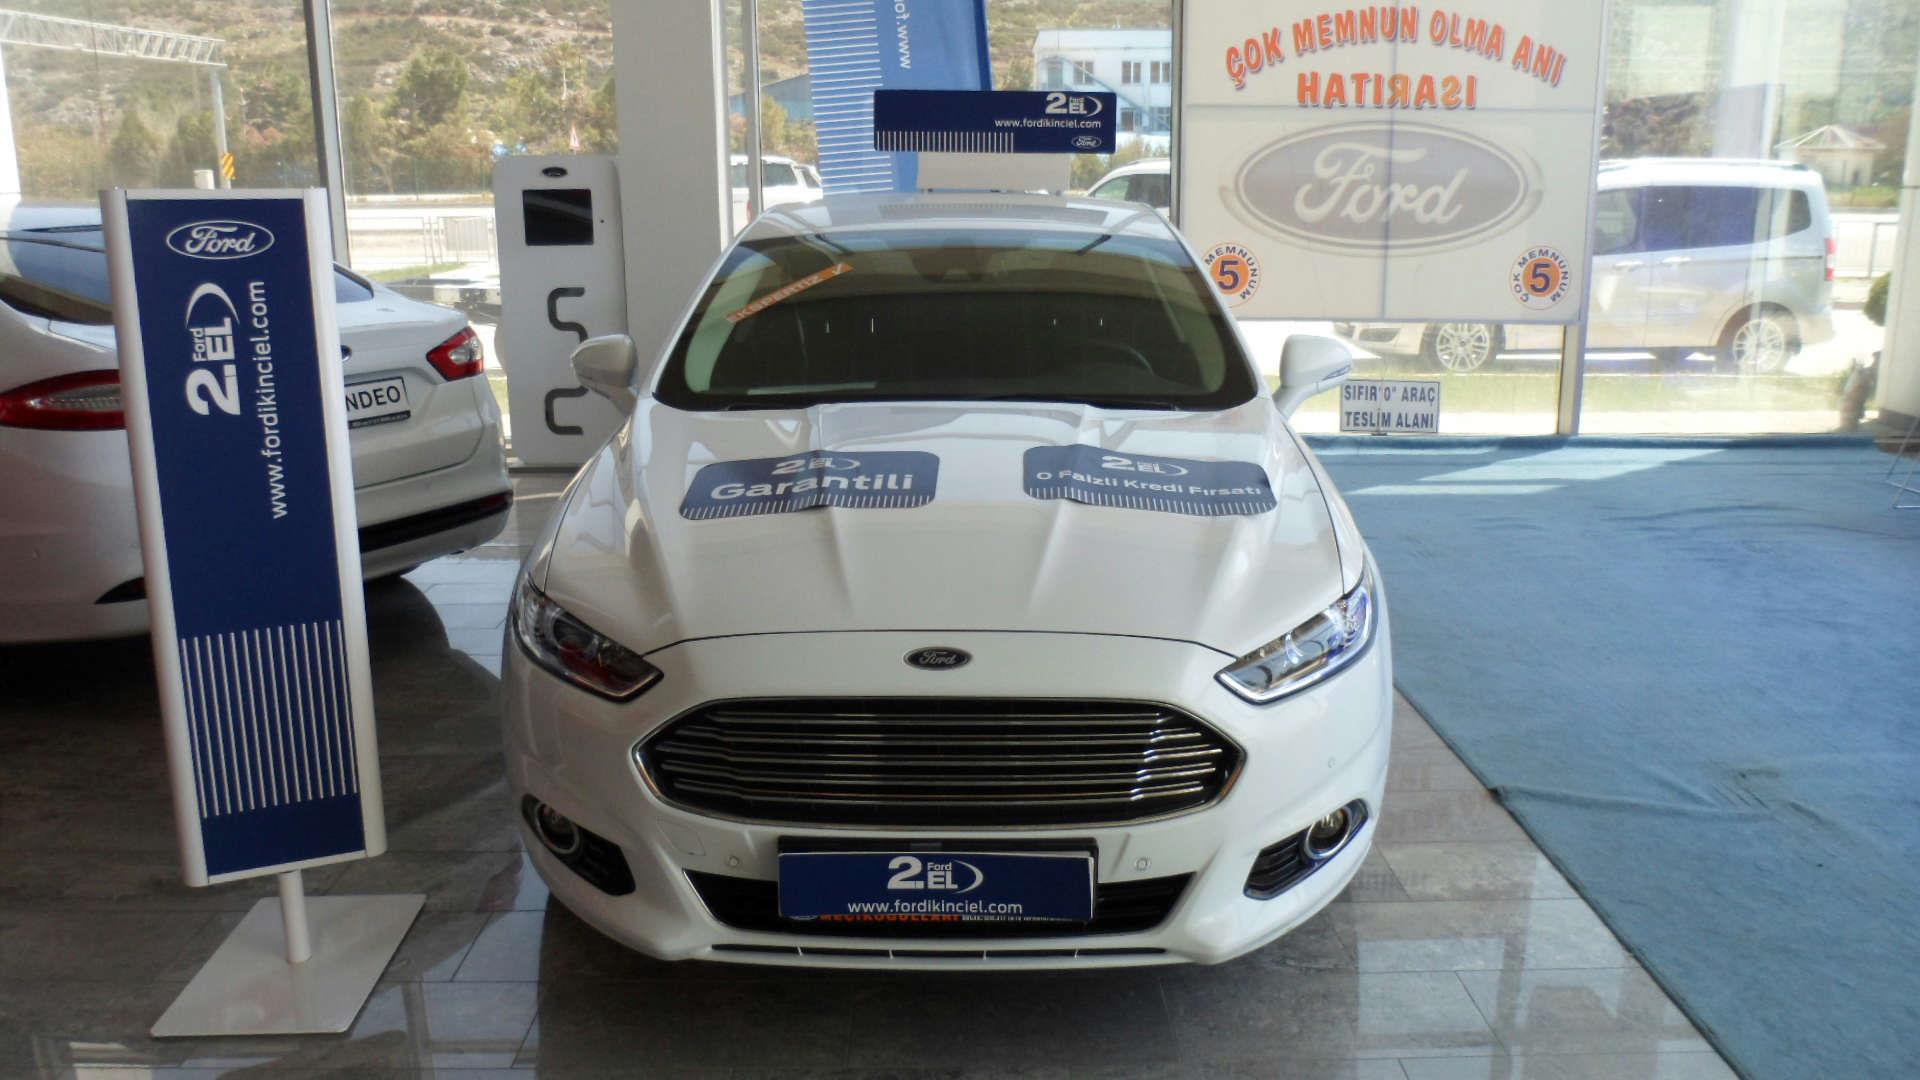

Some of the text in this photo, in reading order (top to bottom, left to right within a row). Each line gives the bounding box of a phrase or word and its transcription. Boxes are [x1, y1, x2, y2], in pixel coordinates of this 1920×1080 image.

[1225, 5, 1567, 90] ÇOK MEMNUN OLMA ANI
[994, 118, 1101, 129] www.fordikinciel.com
[1294, 141, 1469, 225] Ford
[185, 225, 256, 254] Ford
[1218, 260, 1239, 290] 5
[1530, 263, 1552, 293] 5
[189, 327, 207, 362] Ford
[205, 316, 236, 361] EL
[250, 281, 288, 519] www.fordikinciel.com
[1344, 384, 1378, 401] SIFIR
[1401, 387, 1436, 406] ARAÇ
[1395, 412, 1434, 429] ALANI
[710, 473, 914, 500] Garantili
[1124, 479, 1183, 494] Kredi
[927, 861, 952, 871] Ford
[927, 870, 958, 889] EL
[847, 899, 1023, 914] www.fordikinciel.com
